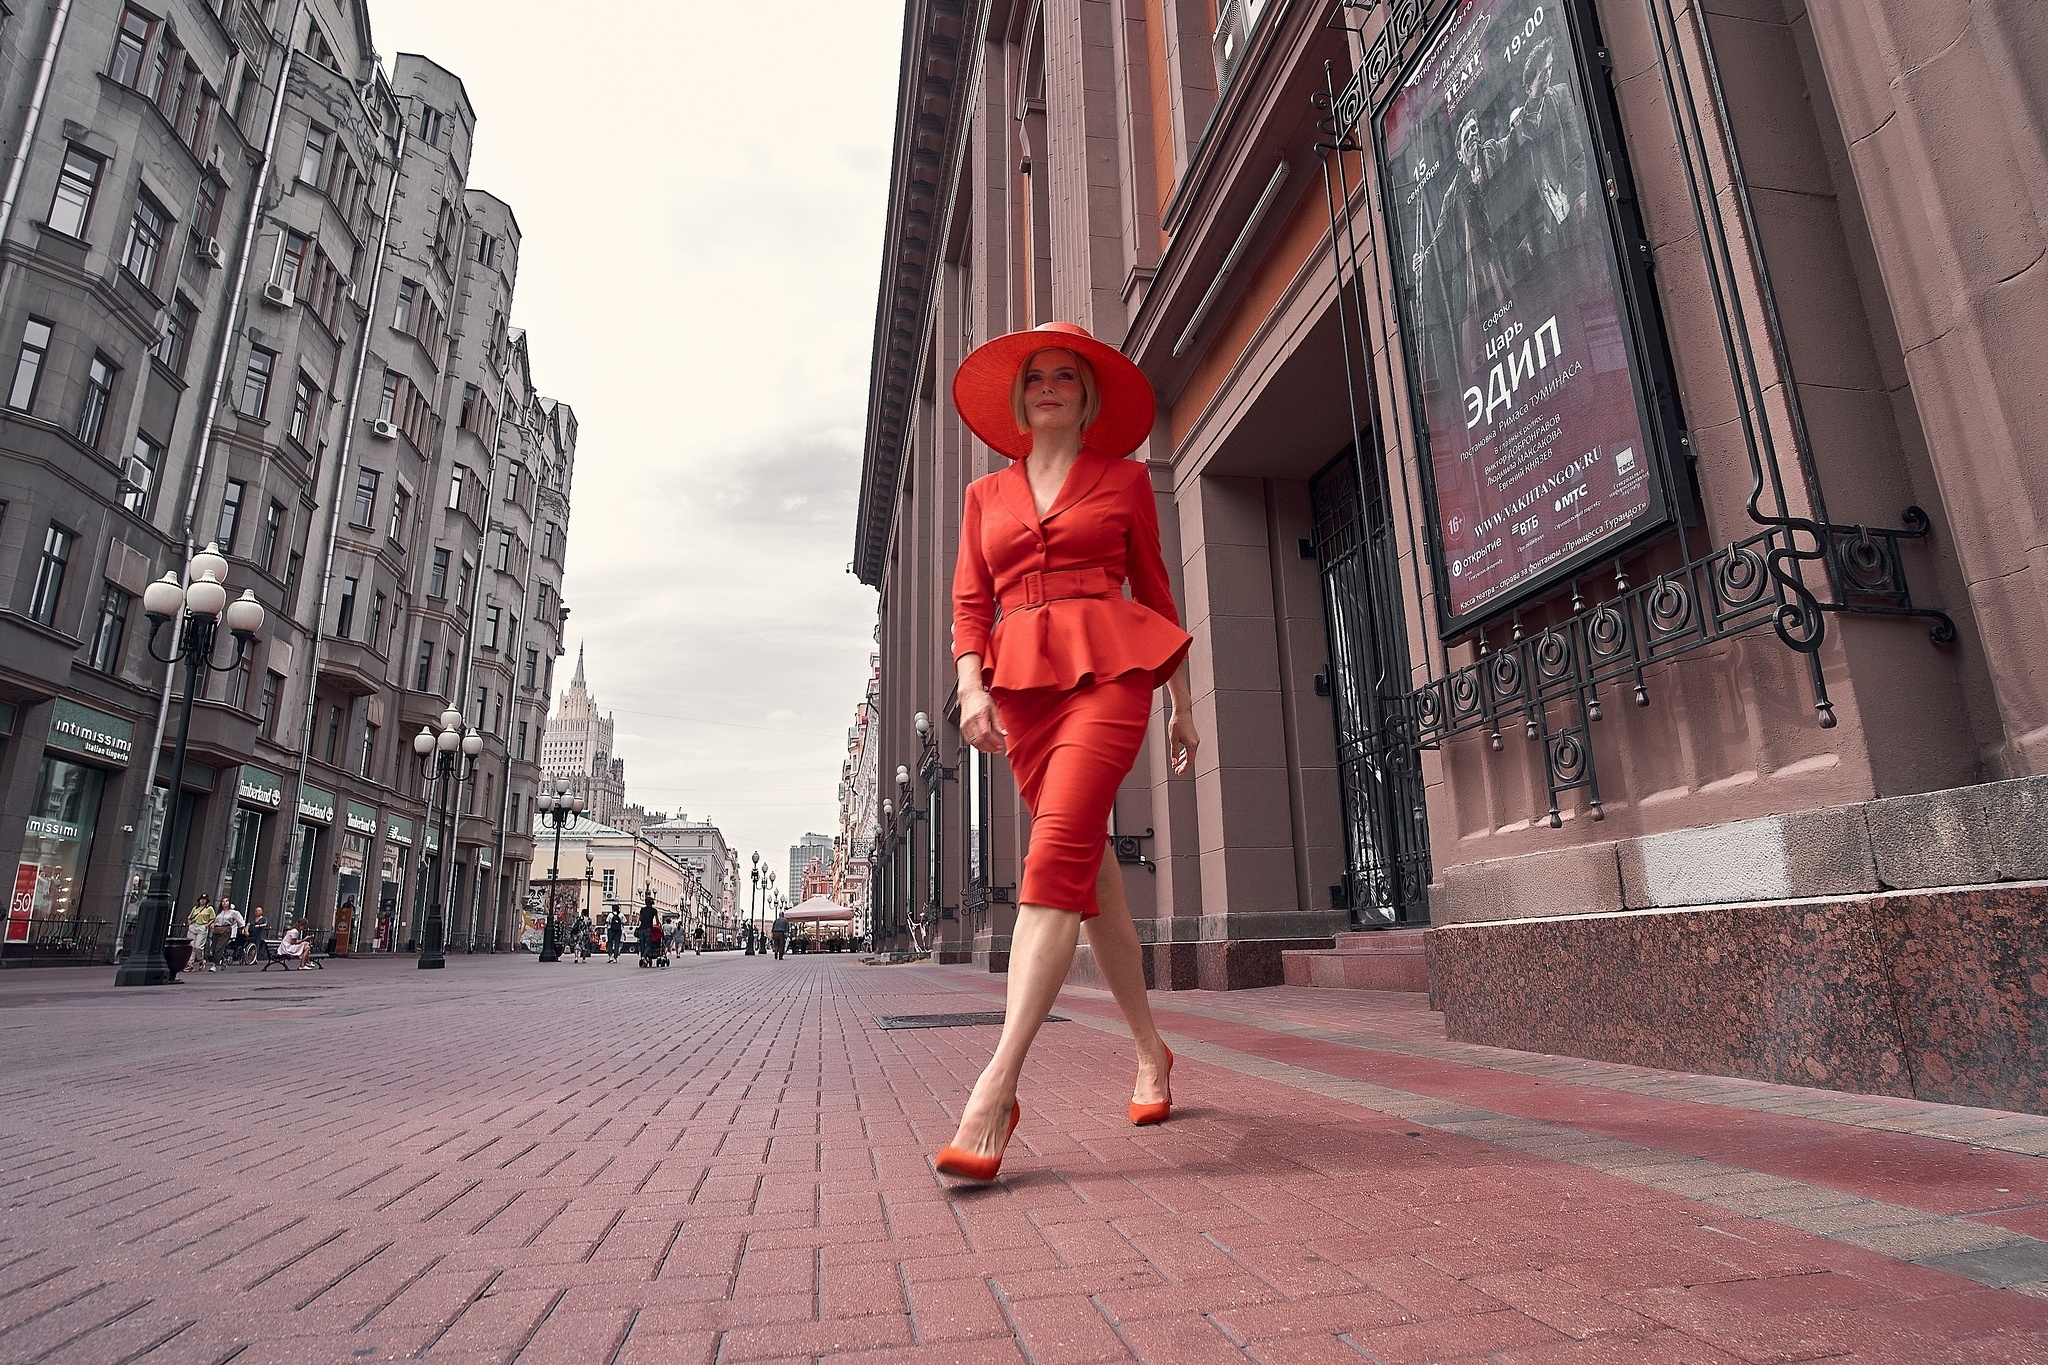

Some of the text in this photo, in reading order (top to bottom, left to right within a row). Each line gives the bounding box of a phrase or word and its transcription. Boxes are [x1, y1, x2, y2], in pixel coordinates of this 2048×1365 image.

[1503, 5, 1544, 63] 19:00
[1412, 35, 1449, 86] Открытие
[1444, 49, 1482, 103] ТЕАТР
[1407, 160, 1440, 205] сентября
[1413, 156, 1427, 182] 15
[1482, 299, 1514, 332] Софокл
[1485, 320, 1524, 361] Царь
[1463, 314, 1562, 430] ЭДИП
[1460, 360, 1583, 462] Постановка Римаса ТУМИНАСА
[1484, 413, 1562, 476] Виктор ДОБРОНРАВОВ
[1516, 427, 1563, 467] МАКСАКОВА
[1474, 445, 1603, 538] WWW.VAKHTANGOV.RU
[1498, 447, 1554, 492] Евгений КНЯЗЕВ
[1561, 482, 1589, 509] МТС
[1448, 515, 1463, 536] 16+
[1519, 514, 1539, 537] ВТБ
[1463, 537, 1502, 568] открытие
[1460, 598, 1476, 611] Касса
[1476, 585, 1496, 602] театра
[1499, 573, 1520, 588] справа
[1528, 547, 1562, 575] фонтаном
